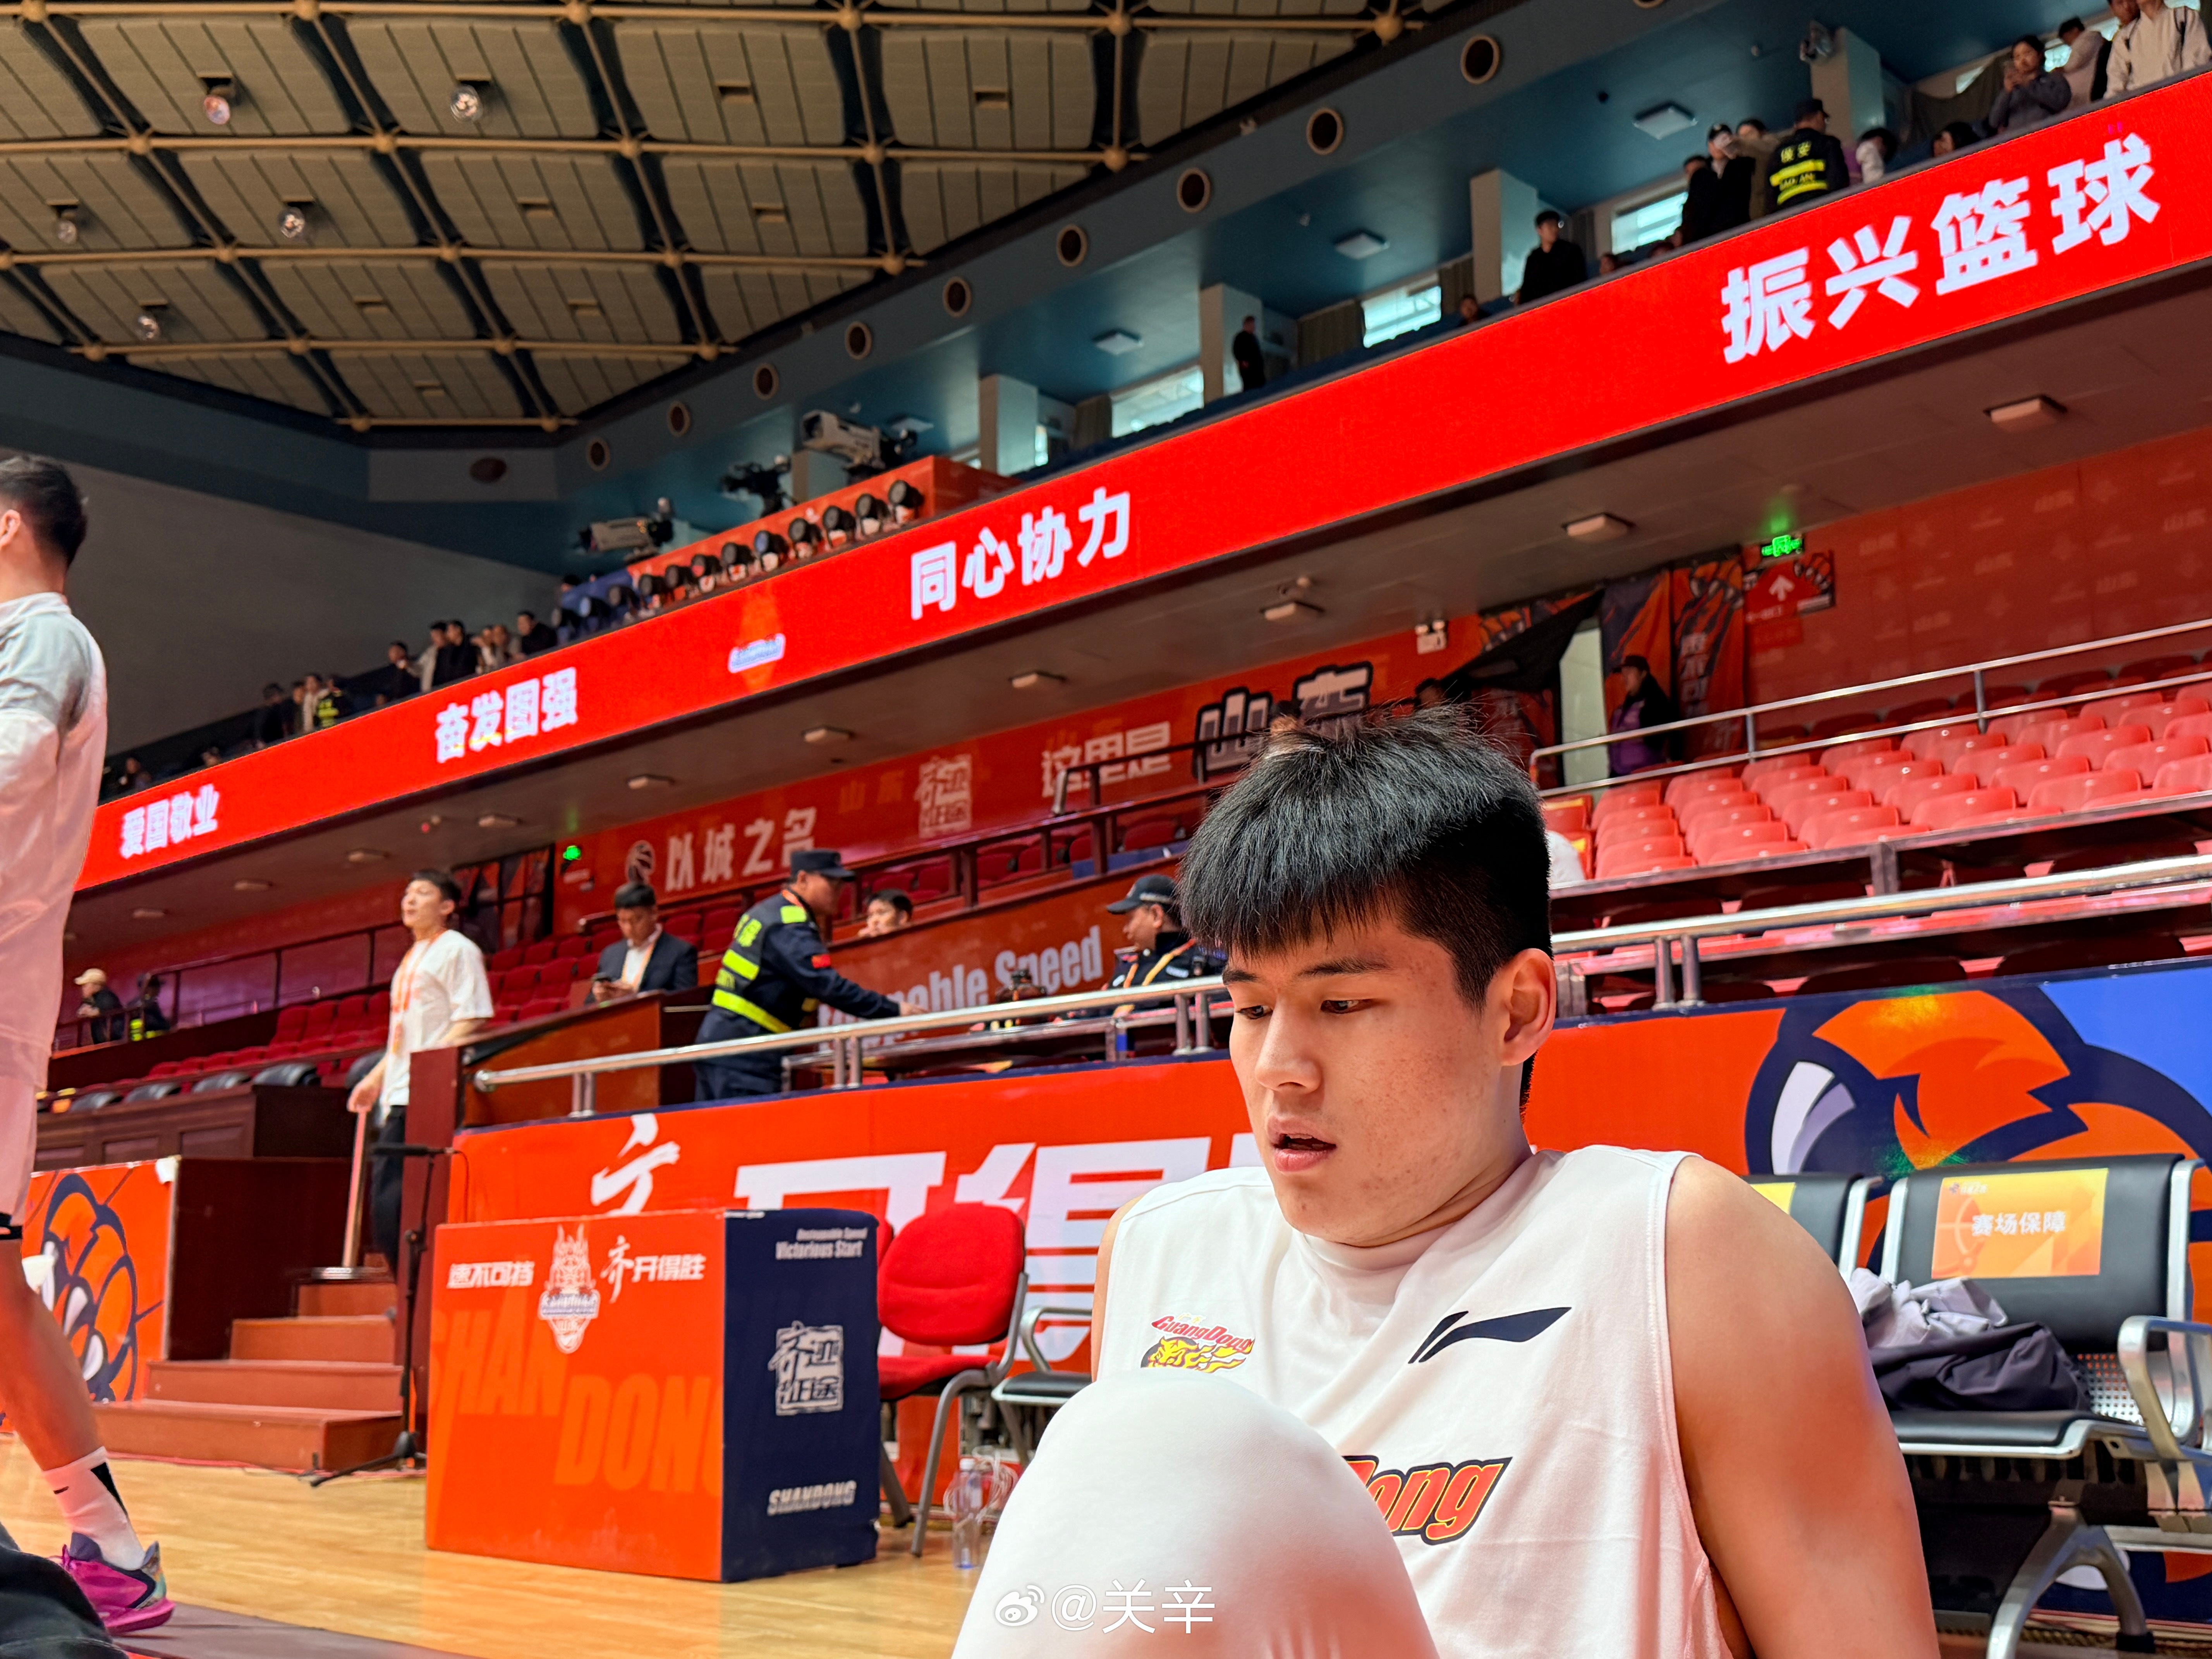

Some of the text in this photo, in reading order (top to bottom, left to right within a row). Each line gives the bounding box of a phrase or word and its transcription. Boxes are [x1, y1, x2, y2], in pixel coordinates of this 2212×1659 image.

[1721, 133, 2162, 364] 振兴篮球
[910, 487, 1131, 620] 同心协力
[435, 666, 578, 764] 奋发图强
[665, 806, 817, 891] 以城之名
[1971, 1210, 2066, 1237] 赛场保障
[447, 1261, 535, 1289] 速不可挡
[600, 1235, 707, 1304] 齐开得胜
[1151, 1316, 1255, 1353] GuangDong
[767, 1480, 857, 1516] SHANDONG
[1341, 1455, 1513, 1546] ong
